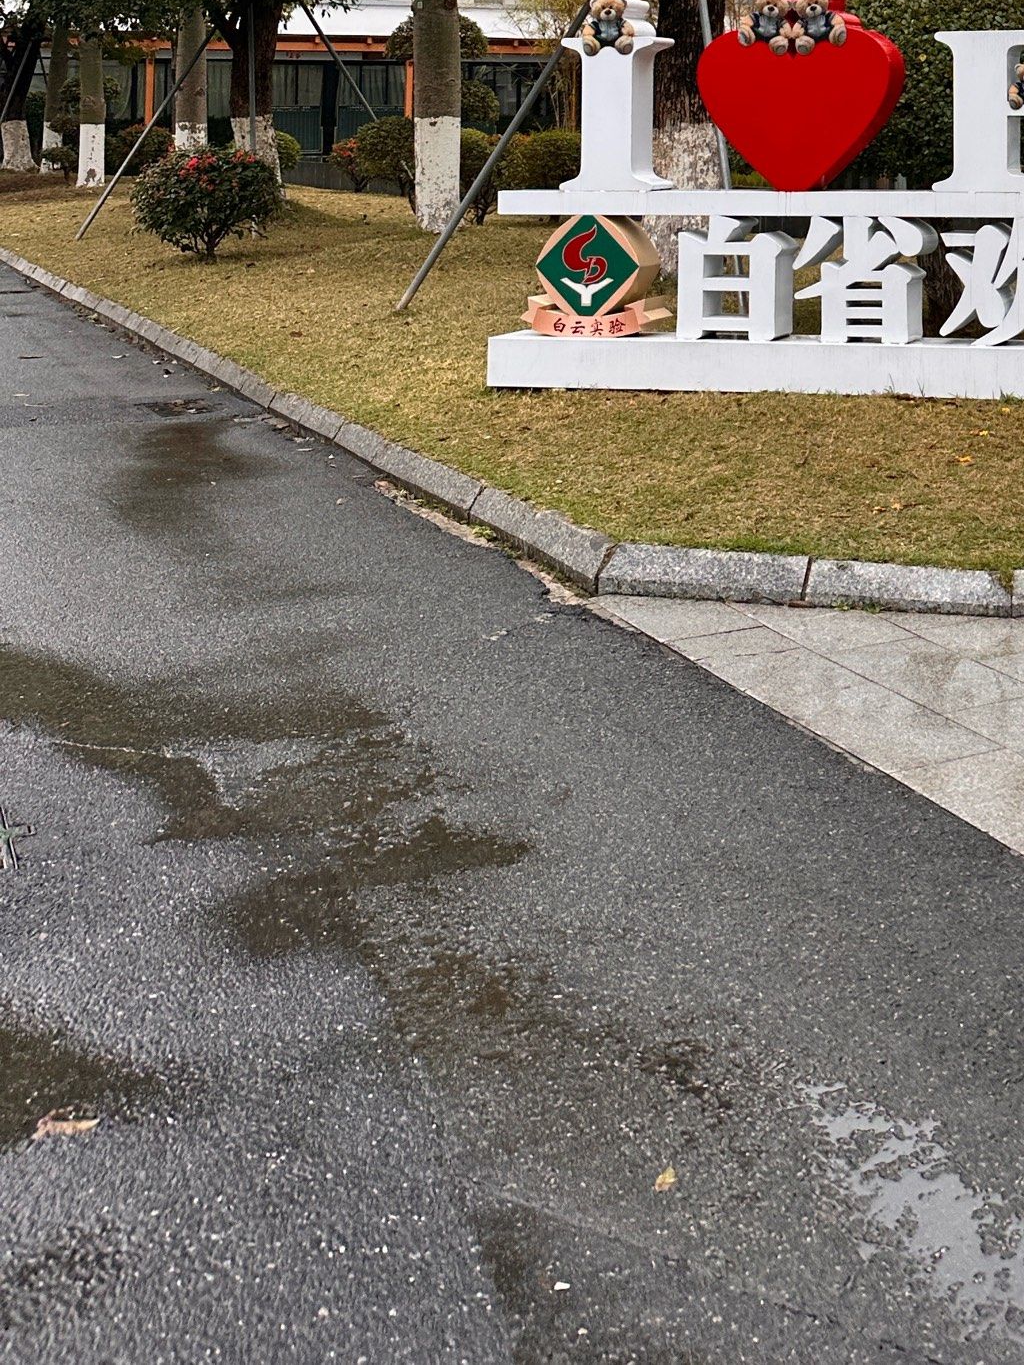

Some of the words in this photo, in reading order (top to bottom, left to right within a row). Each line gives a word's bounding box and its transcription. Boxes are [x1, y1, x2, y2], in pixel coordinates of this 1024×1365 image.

[559, 29, 675, 192] I
[553, 317, 626, 335] 白云实验
